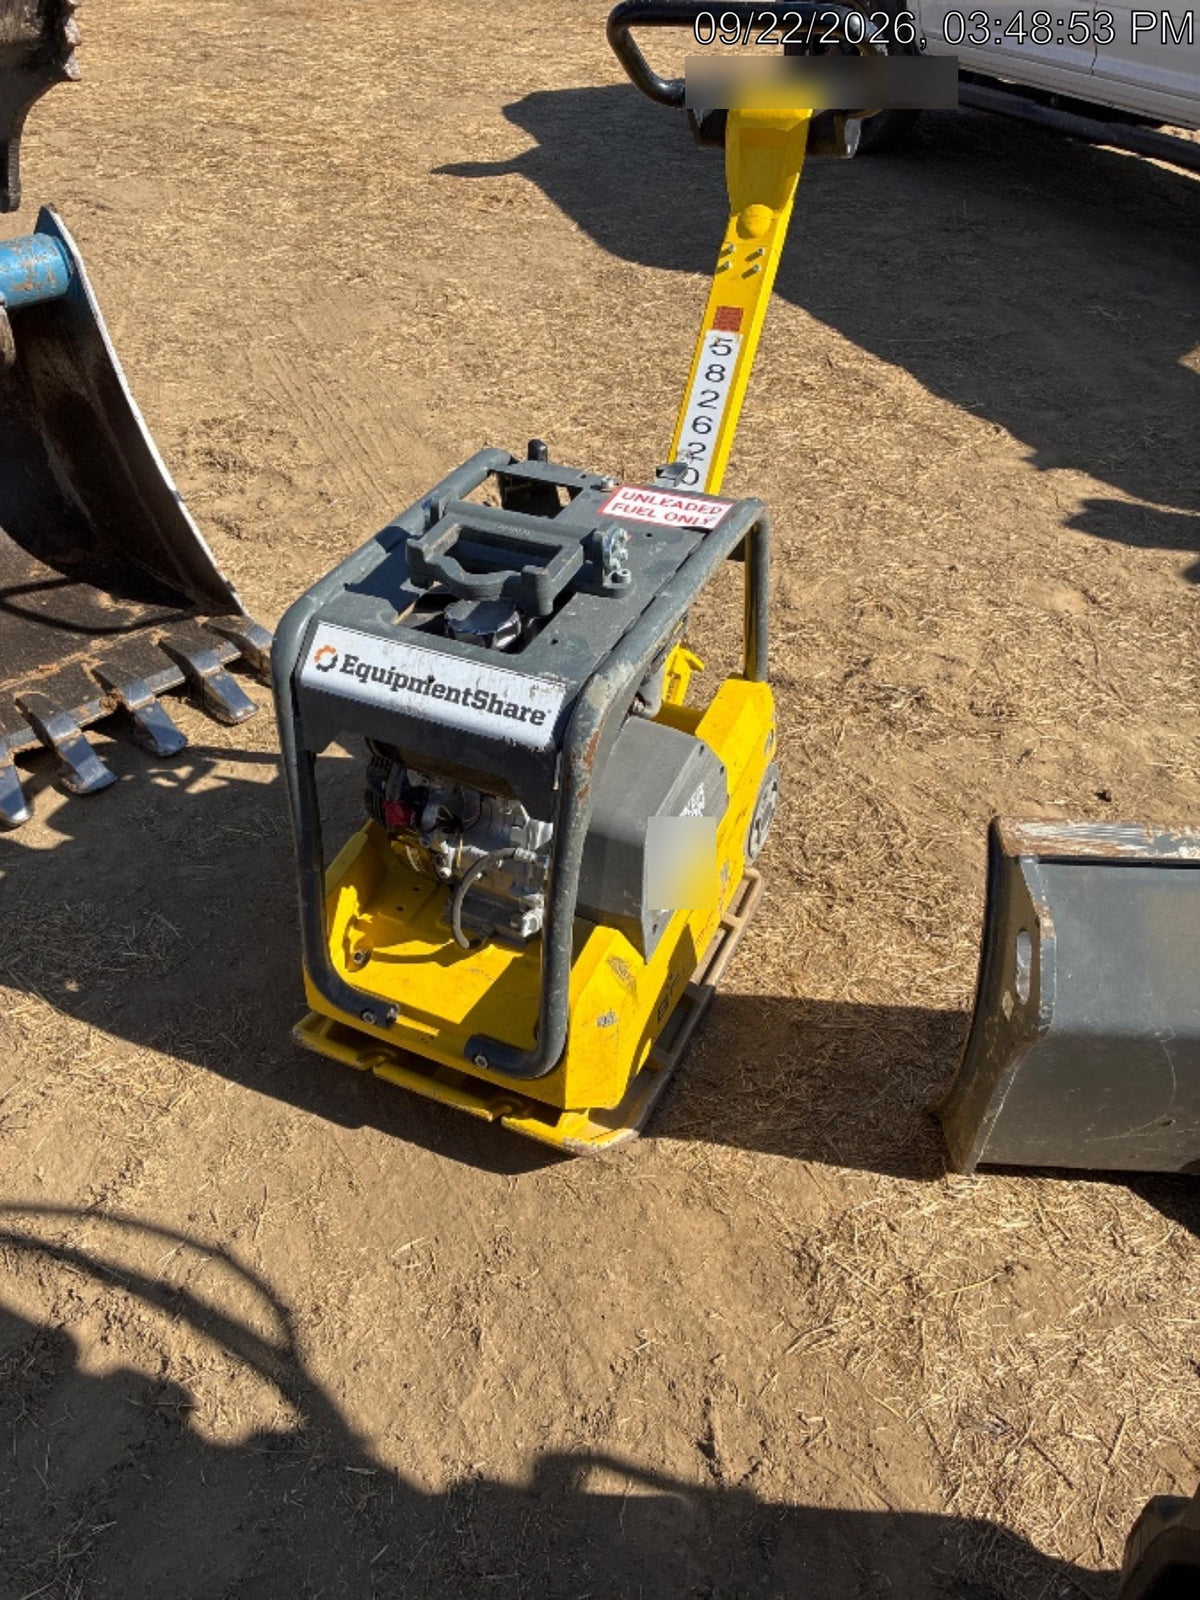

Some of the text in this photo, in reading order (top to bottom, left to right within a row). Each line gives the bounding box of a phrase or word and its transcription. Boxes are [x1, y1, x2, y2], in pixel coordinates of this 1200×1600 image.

[611, 502, 715, 525] FUEL ONLY
[621, 491, 723, 515] UNLEADED
[339, 653, 547, 726] EquipmentShare
